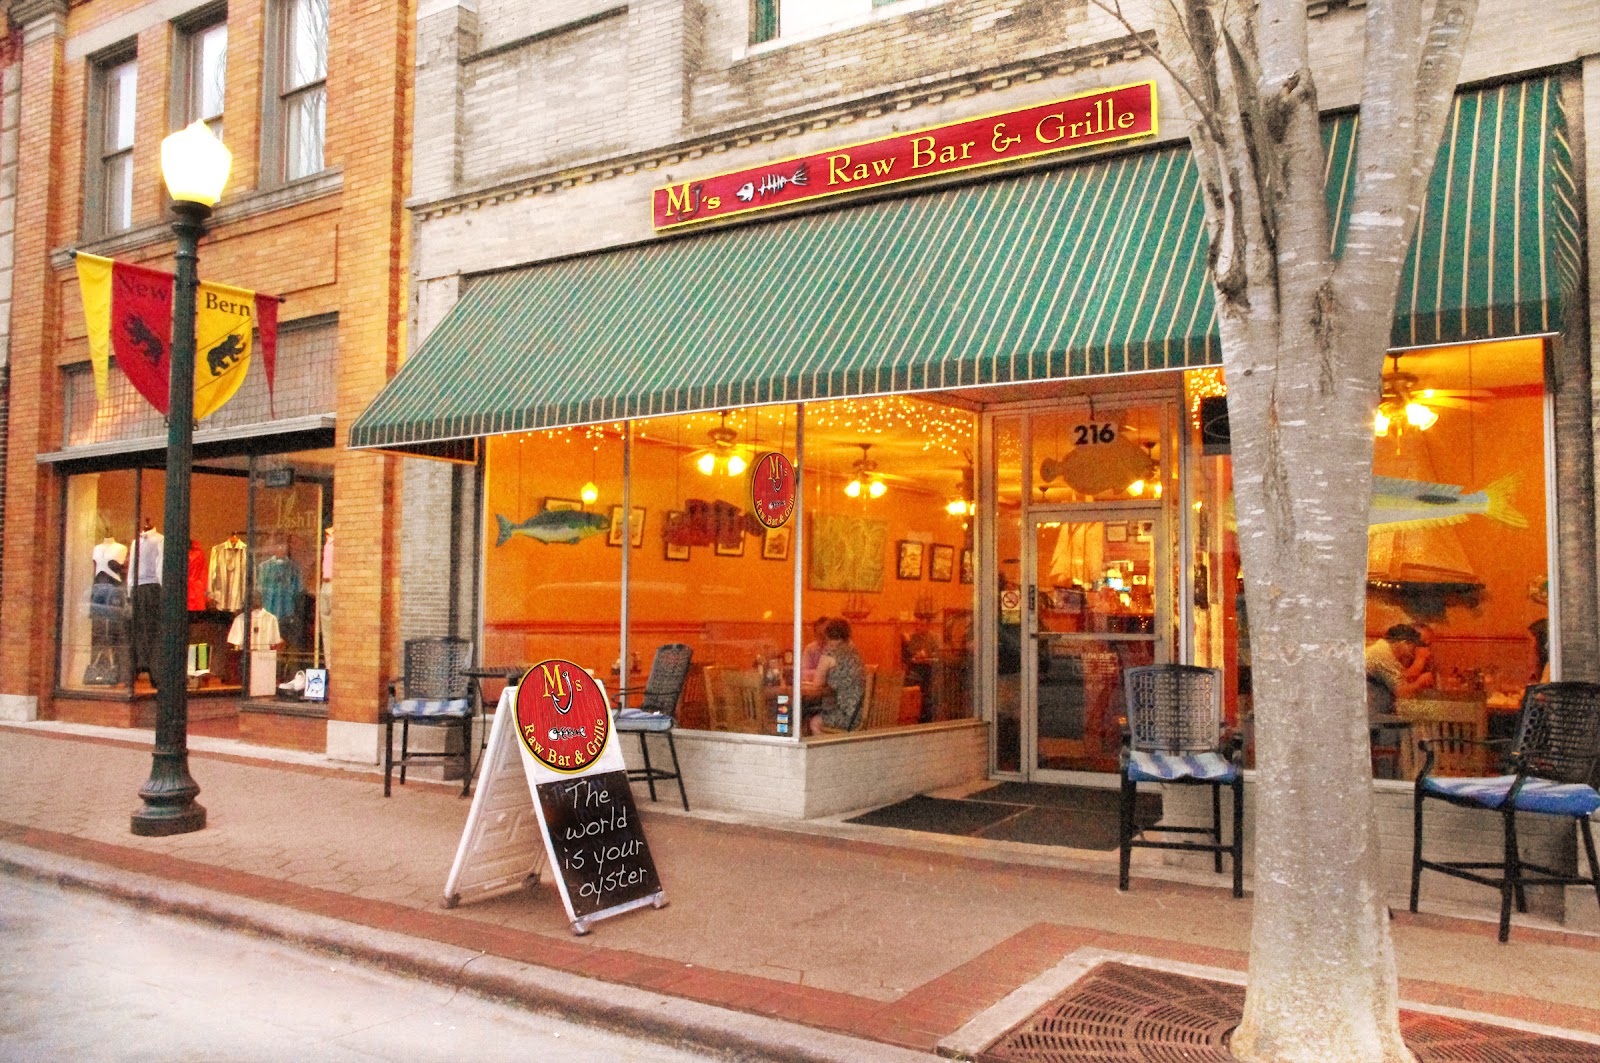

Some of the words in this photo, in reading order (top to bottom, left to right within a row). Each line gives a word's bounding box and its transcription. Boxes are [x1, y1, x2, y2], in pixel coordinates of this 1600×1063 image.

[827, 153, 896, 186] Raw
[910, 136, 976, 170] Bar
[991, 123, 1021, 152] &
[1035, 98, 1135, 144] Grille
[117, 273, 167, 301] New
[205, 291, 251, 317] Bern
[1074, 423, 1115, 445] 216
[756, 499, 766, 520] Raw
[766, 515, 778, 525] Bar
[784, 494, 795, 517] Grille
[524, 723, 545, 756] Raw
[547, 748, 571, 766] Bar
[574, 749, 585, 765] &
[586, 718, 605, 756] Grille
[565, 780, 611, 809] The
[566, 806, 628, 840] world
[564, 847, 585, 870] is
[593, 839, 644, 875] your
[579, 864, 648, 905] oyster
